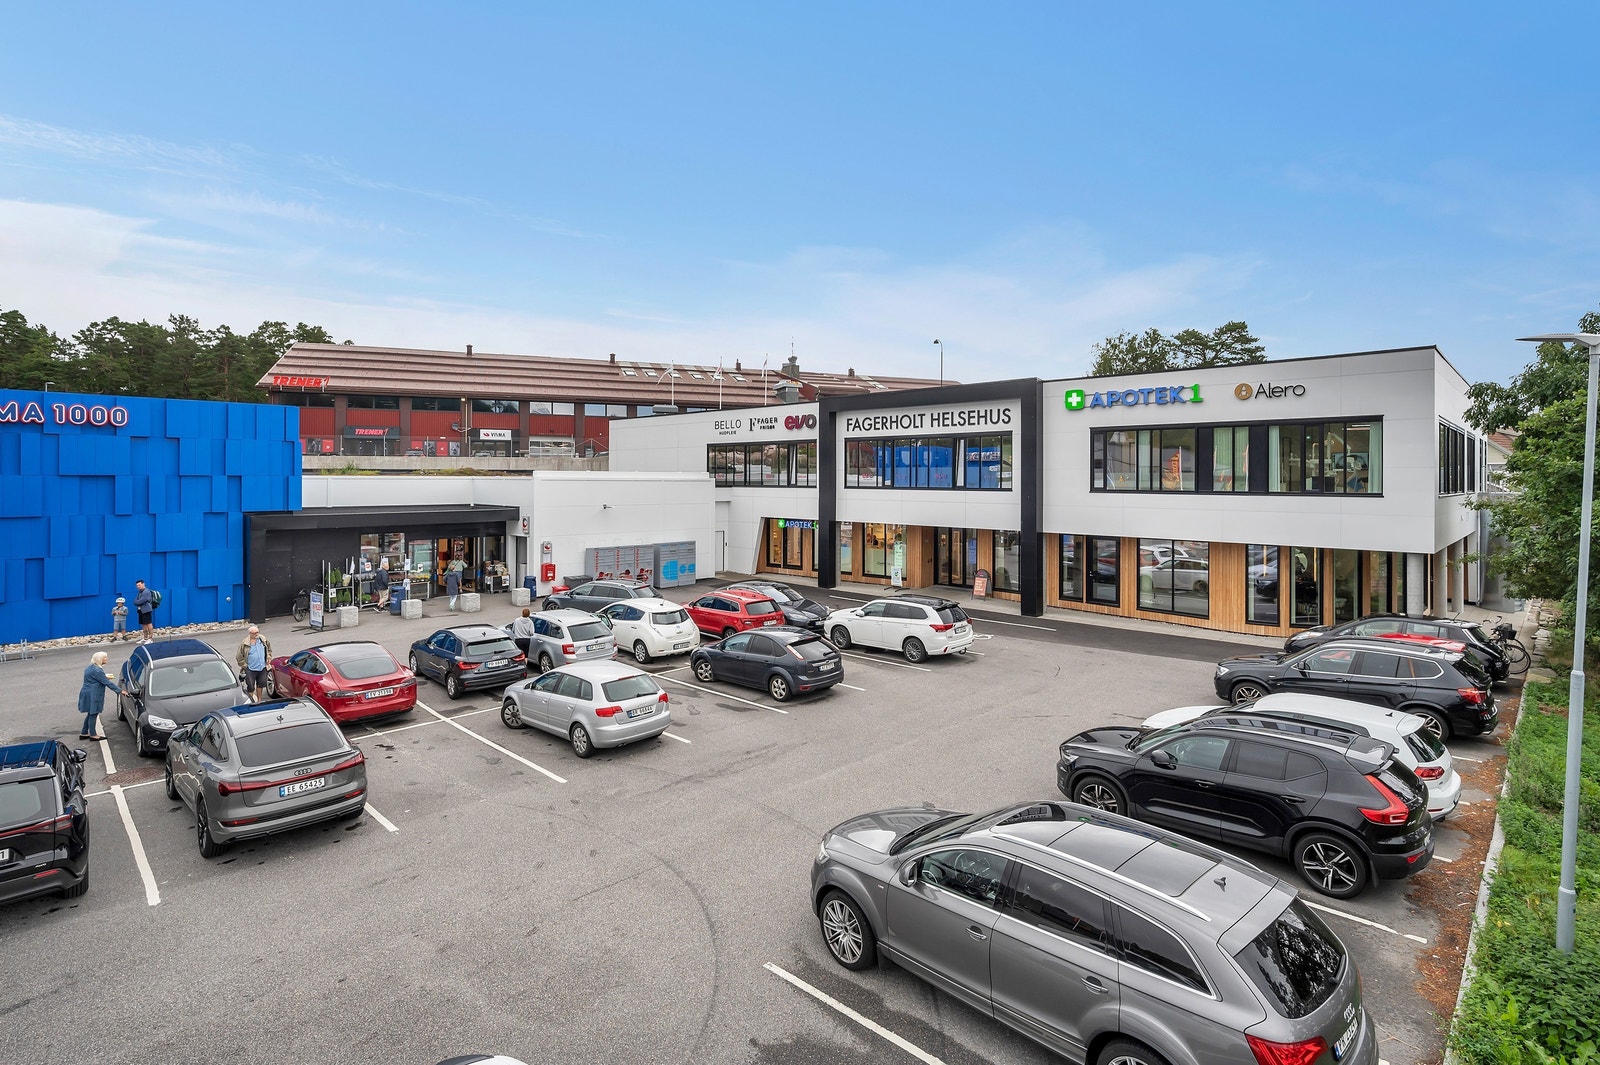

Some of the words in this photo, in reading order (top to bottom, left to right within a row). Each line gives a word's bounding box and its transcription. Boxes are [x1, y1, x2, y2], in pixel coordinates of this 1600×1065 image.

[1255, 383, 1306, 399] Alero
[53, 403, 128, 427] 1000
[757, 417, 778, 425] FAGER
[784, 413, 817, 431] evo
[846, 413, 926, 432] FAGERHOLT
[930, 408, 1012, 428] HELSEHUS
[714, 419, 742, 430] BELLO
[287, 785, 296, 794] EE
[299, 779, 323, 791] 65425
